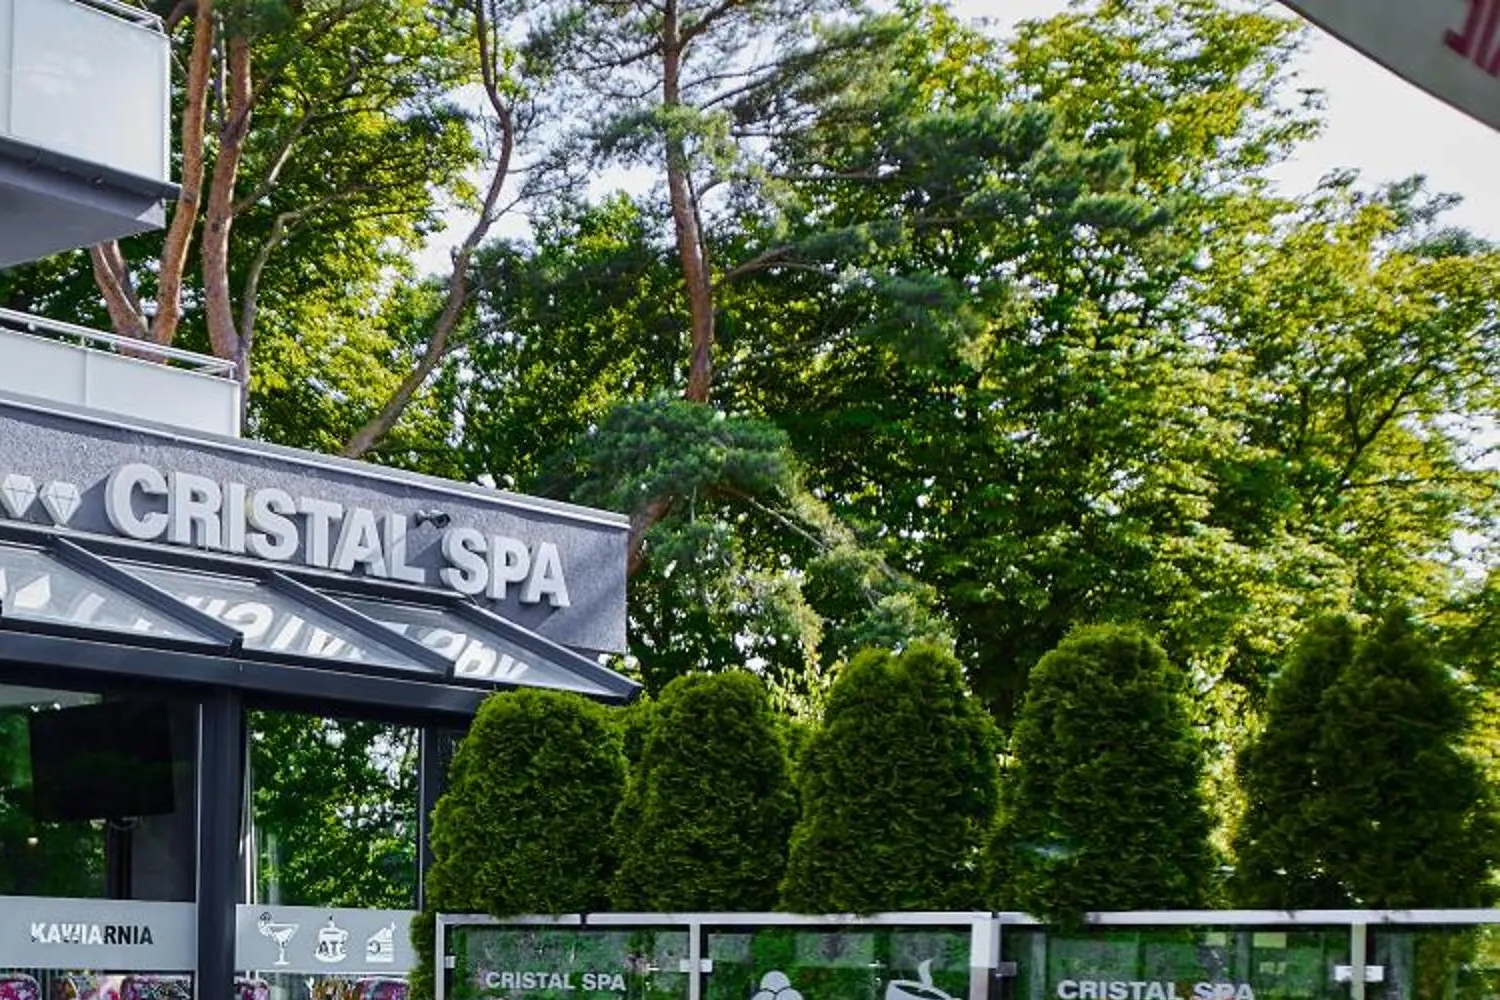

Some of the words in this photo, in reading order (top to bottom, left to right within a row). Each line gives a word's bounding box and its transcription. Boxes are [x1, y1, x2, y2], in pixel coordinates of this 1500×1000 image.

[106, 463, 426, 583] CRISTAL
[442, 527, 571, 608] SPA
[31, 921, 154, 945] KAWIARNIA
[485, 971, 575, 990] CRISTAL
[582, 972, 626, 991] SPA
